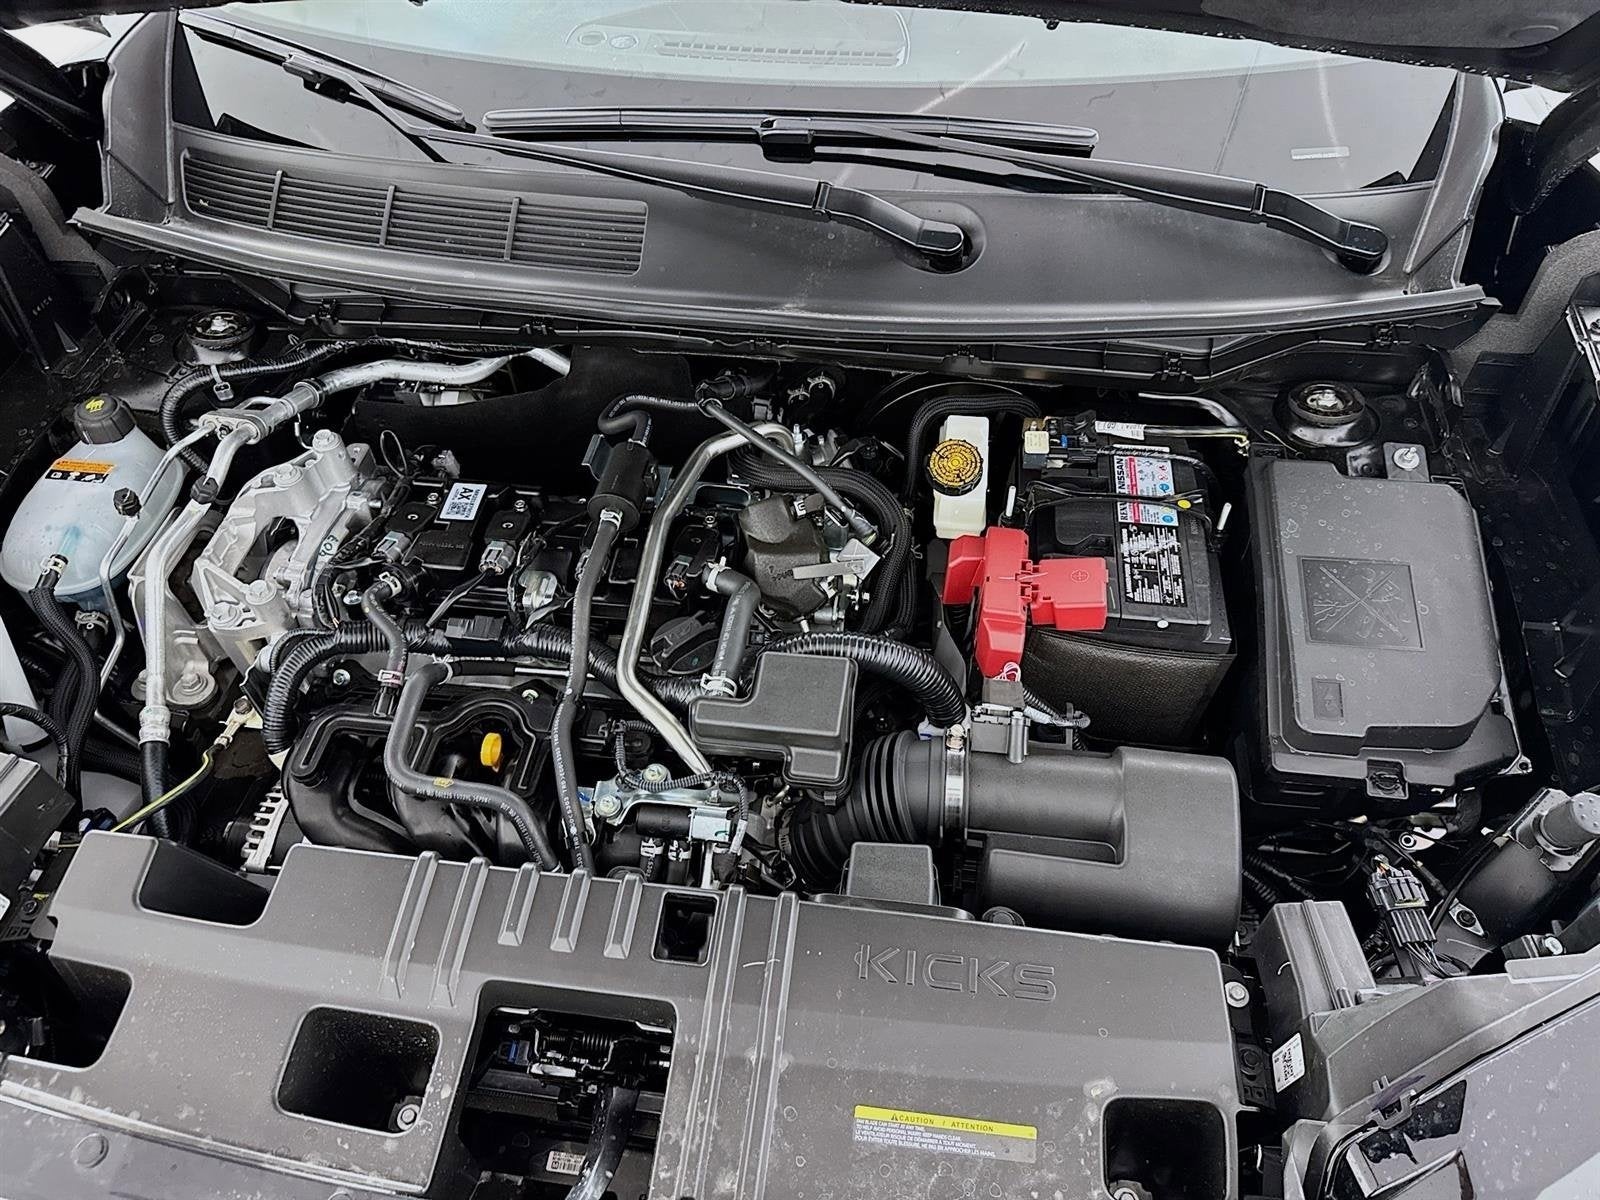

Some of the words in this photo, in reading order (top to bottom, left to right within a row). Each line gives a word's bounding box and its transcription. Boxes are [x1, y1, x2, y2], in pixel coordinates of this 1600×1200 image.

[1116, 458, 1126, 490] NISSAN
[458, 487, 474, 500] AX
[858, 945, 1056, 1001] KICKS
[898, 1116, 934, 1125] CAUTION
[951, 1121, 994, 1132] ATTENTION
